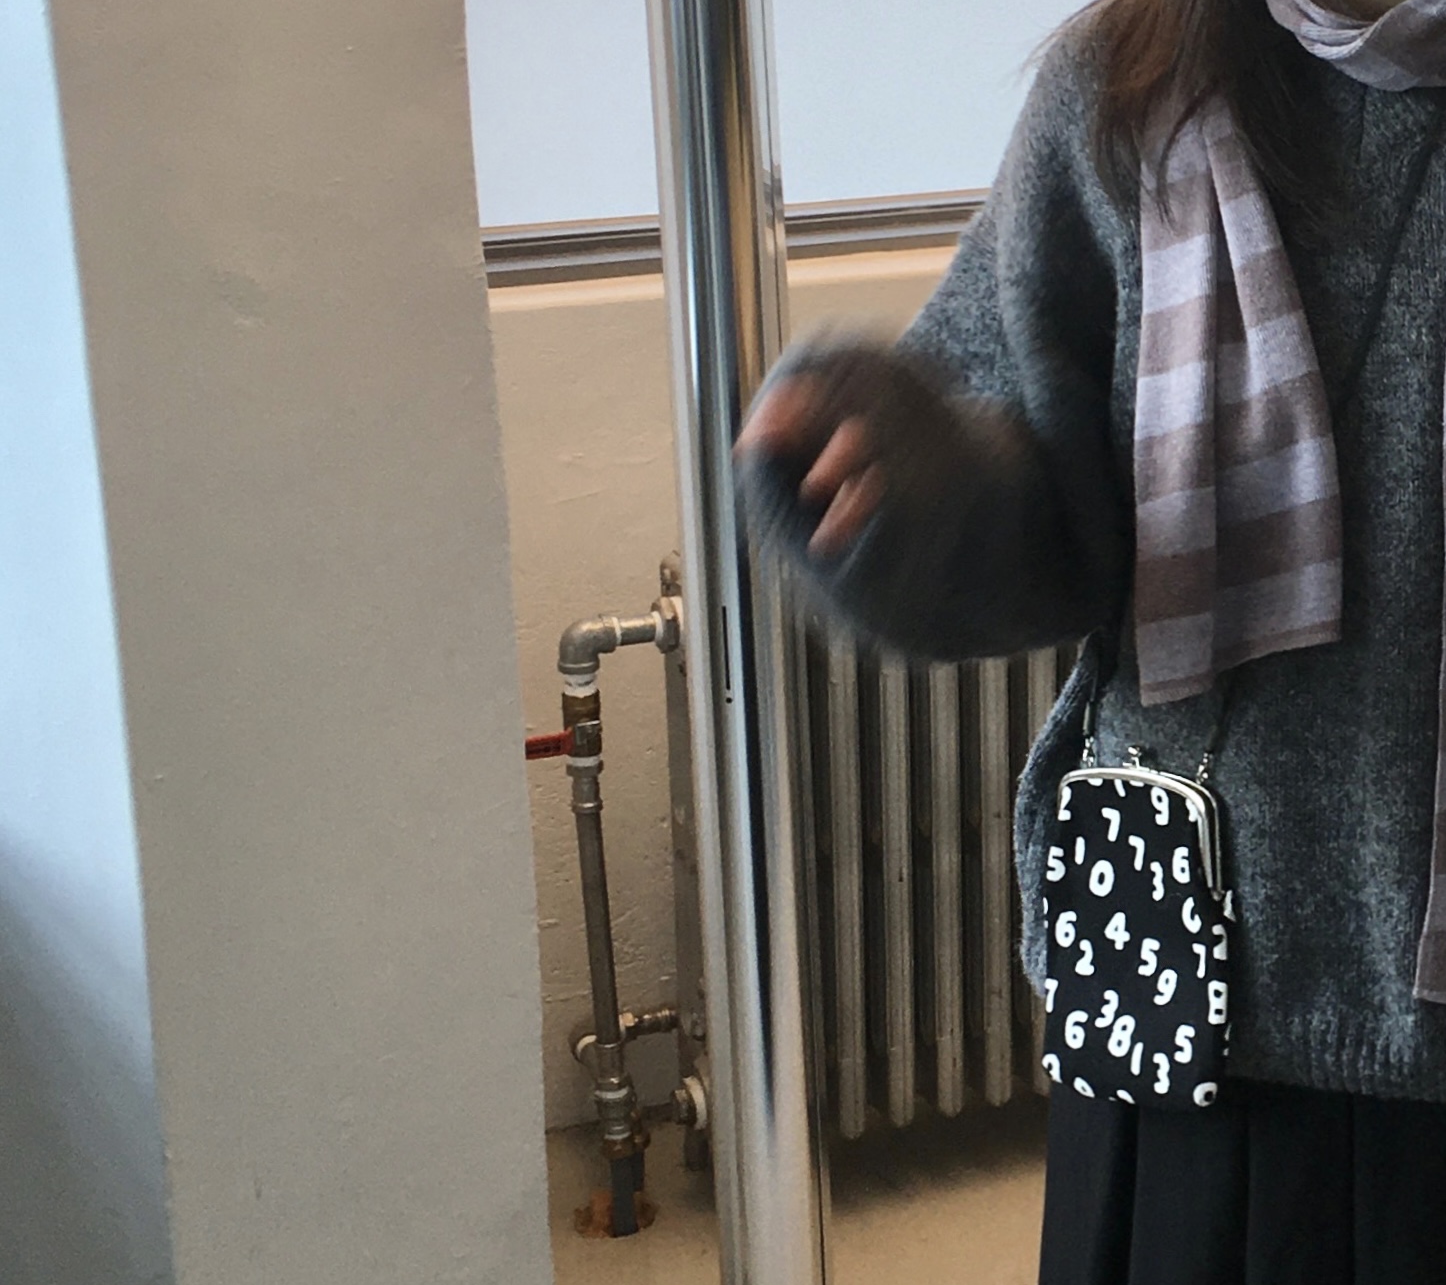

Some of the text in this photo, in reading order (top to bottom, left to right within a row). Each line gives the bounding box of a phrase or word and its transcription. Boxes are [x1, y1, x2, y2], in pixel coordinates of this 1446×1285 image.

[1102, 807, 1121, 842] 7
[1151, 786, 1170, 826] 9
[1046, 845, 1066, 882] 5
[1075, 836, 1086, 865] 1
[1128, 835, 1145, 871] 7
[1172, 846, 1191, 884] 6
[1089, 860, 1115, 897] 0
[1150, 861, 1165, 901] 3
[1055, 911, 1077, 948] 6
[1104, 912, 1131, 950] 4
[1074, 939, 1095, 976] 2
[1138, 938, 1161, 976] 5
[1191, 942, 1206, 978] 7
[1153, 969, 1178, 1005] 9
[1208, 980, 1228, 1025] 8
[1095, 990, 1119, 1028] 3
[1064, 1010, 1089, 1049] 6
[1108, 1015, 1136, 1057] 8
[1174, 1024, 1196, 1064] 5
[1131, 1042, 1144, 1076] 1
[1152, 1052, 1171, 1094] 3
